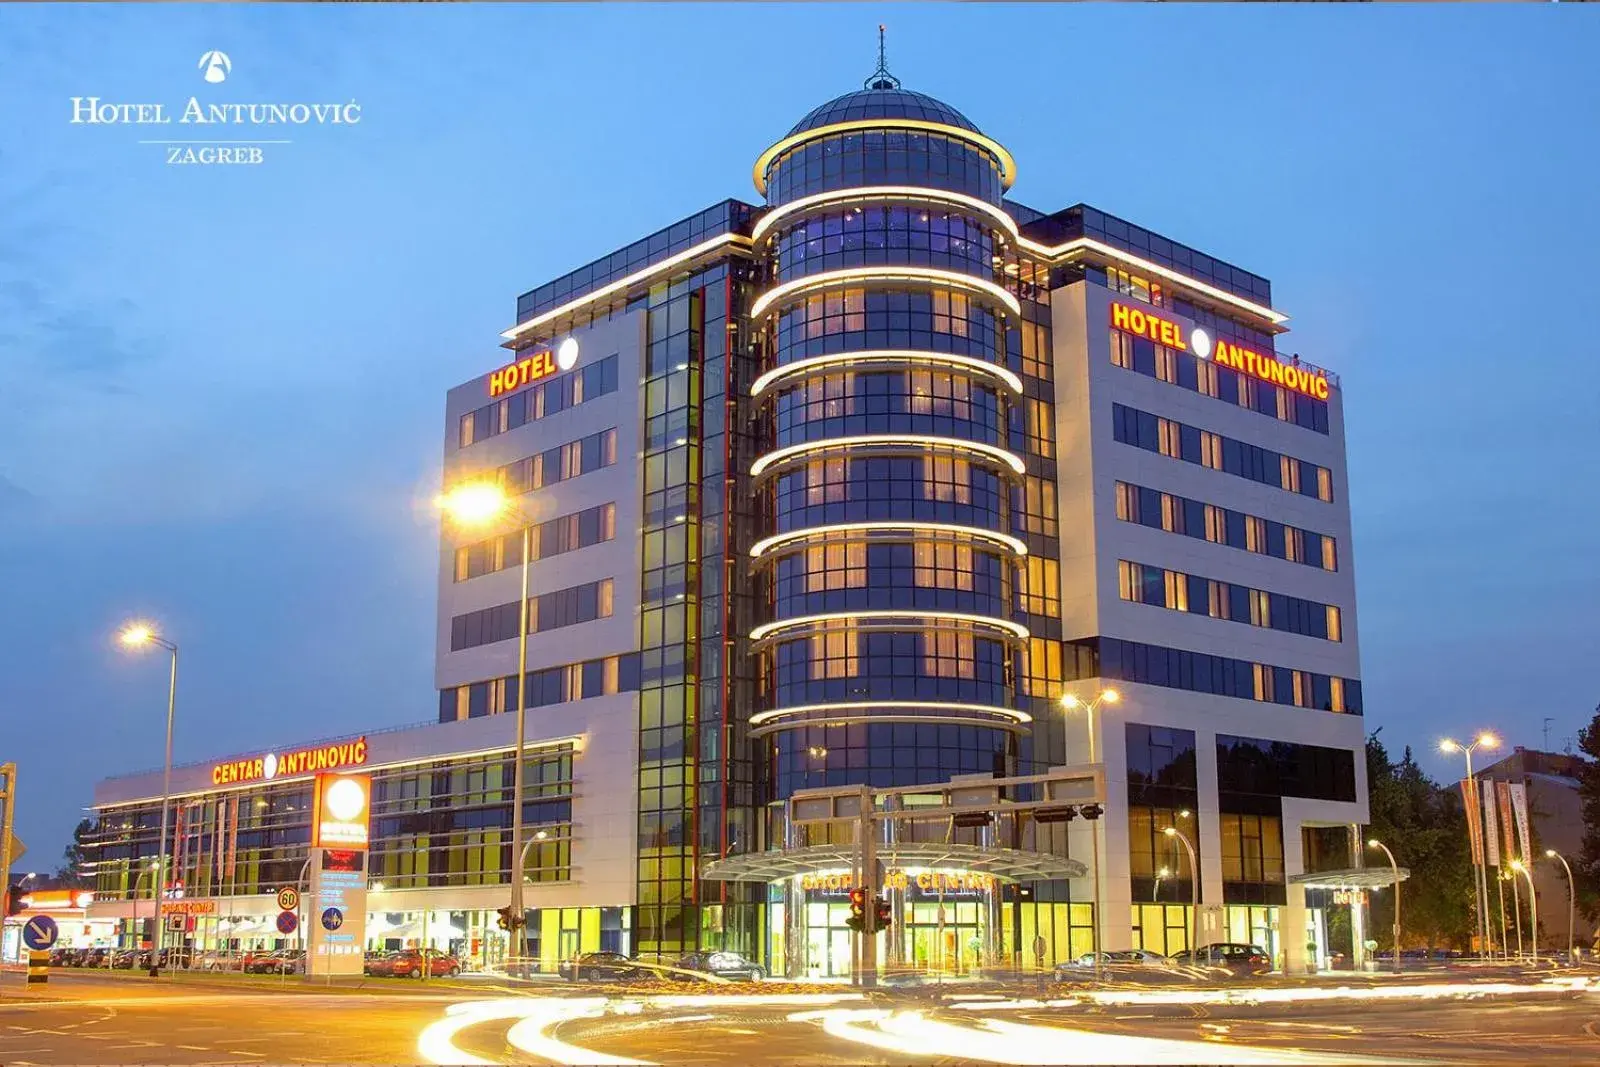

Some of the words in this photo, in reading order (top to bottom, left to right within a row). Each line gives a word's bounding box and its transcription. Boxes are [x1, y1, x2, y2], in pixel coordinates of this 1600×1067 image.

[489, 351, 557, 397] HOTEL
[1111, 302, 1187, 351] HOTEL
[1214, 340, 1329, 400] ANTUNOVIĆ
[212, 759, 263, 785] CENTAR
[277, 736, 368, 775] ANTUNOVIĆ
[281, 893, 294, 905] 60
